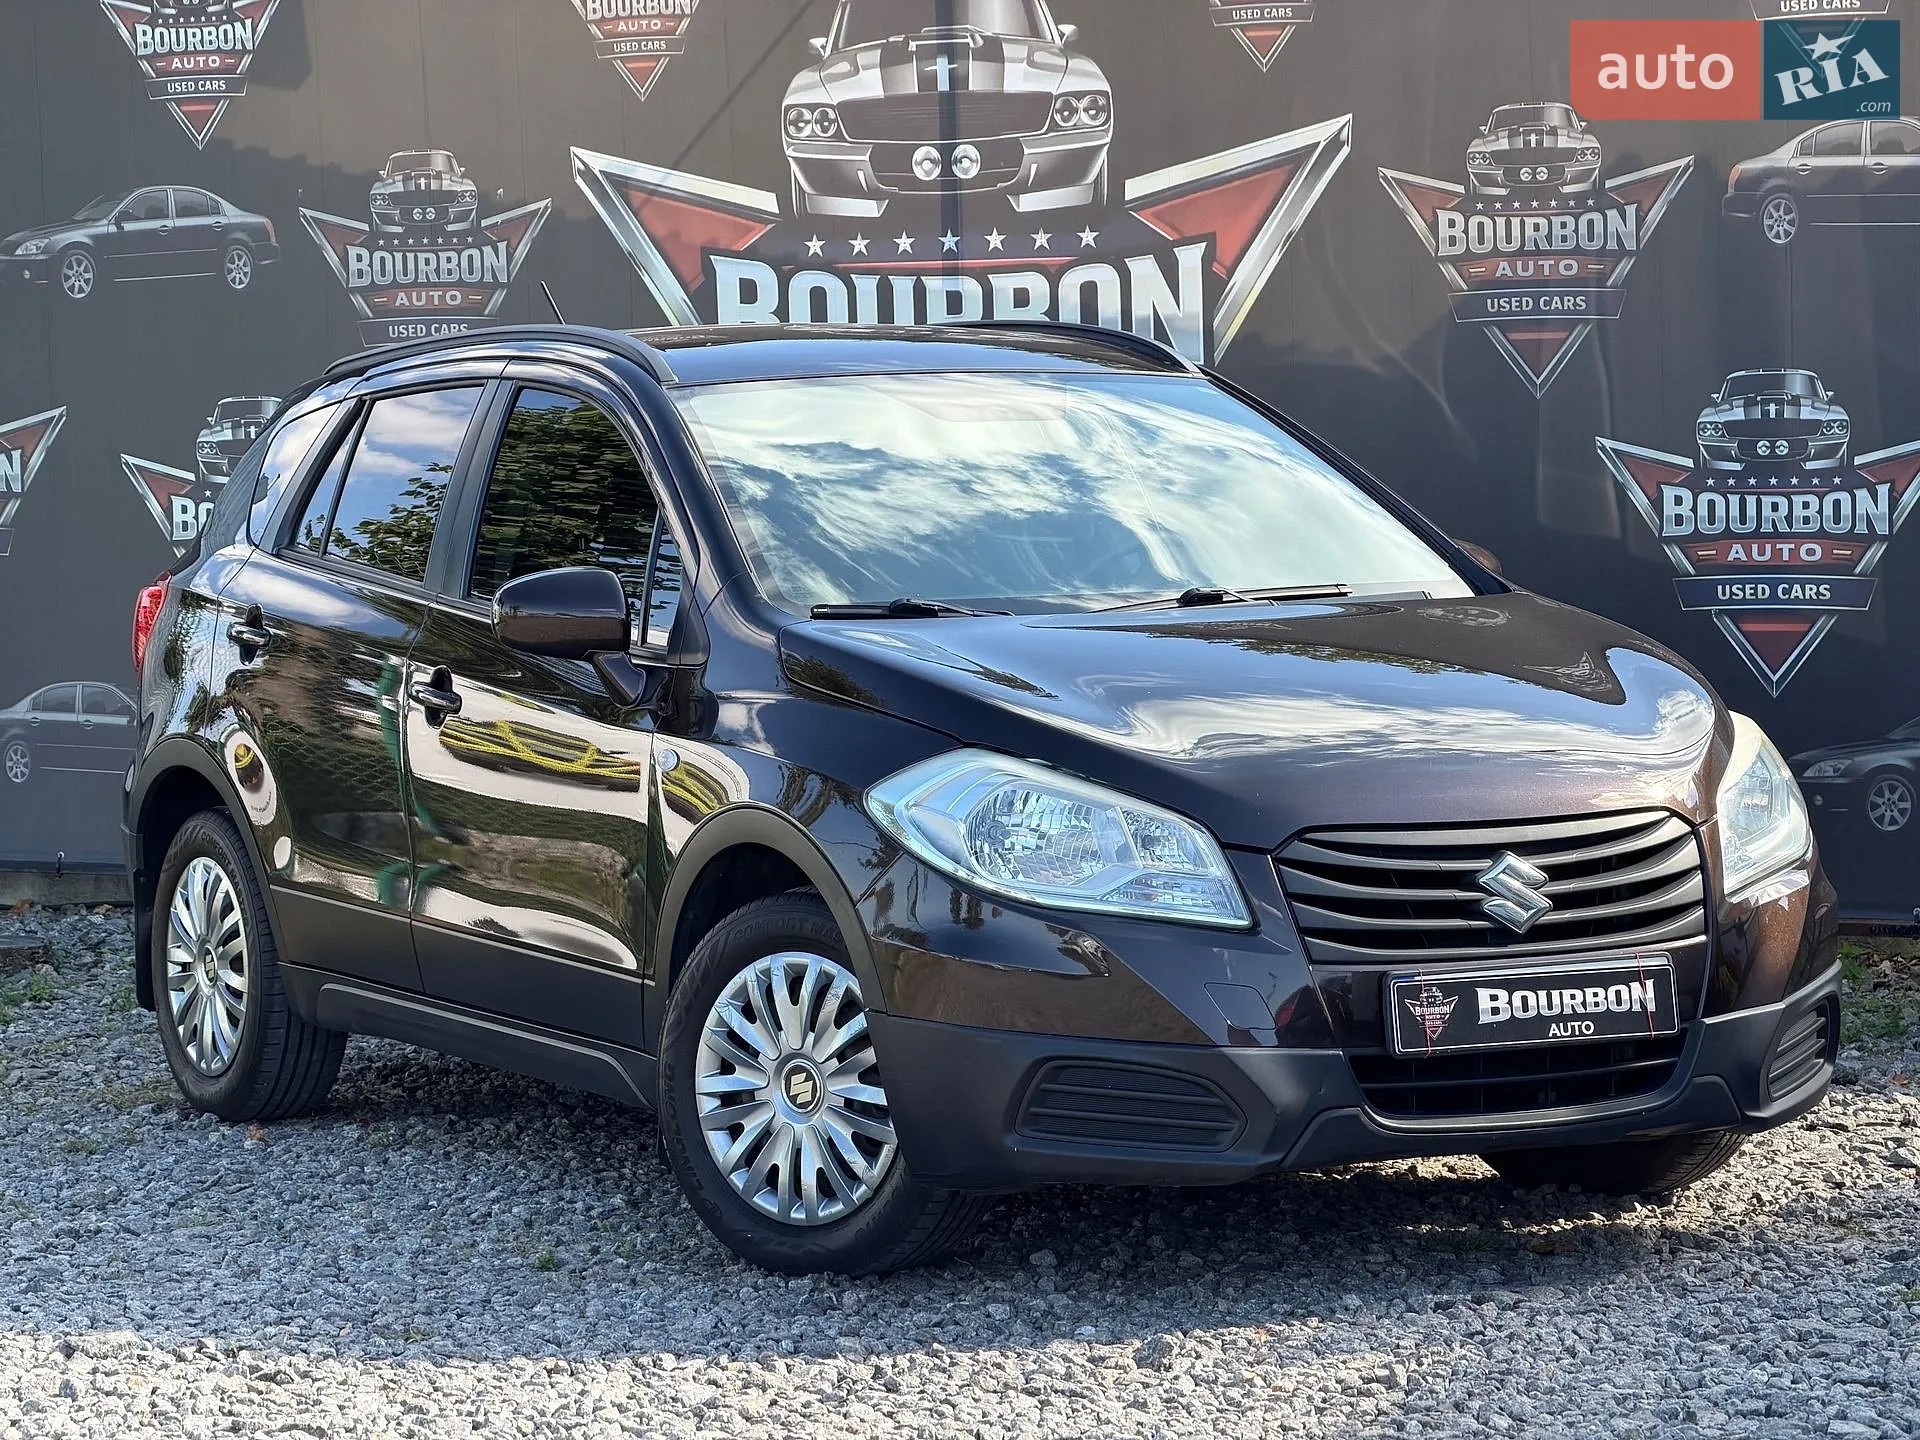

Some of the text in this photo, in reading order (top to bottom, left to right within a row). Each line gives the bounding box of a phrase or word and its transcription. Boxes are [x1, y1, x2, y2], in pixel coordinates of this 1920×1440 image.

[1232, 7, 1293, 20] USED CARS
[1780, 0, 1818, 12] USED
[617, 19, 661, 32] AUTO
[135, 18, 254, 56] BOURBON
[613, 40, 667, 52] USED CARS
[171, 56, 221, 69] AUTO
[167, 80, 226, 93] USED CARS
[1436, 203, 1639, 257] BOURBON
[346, 240, 508, 288] BOURBON
[1495, 258, 1580, 277] AUTO
[394, 289, 463, 307] AUTO
[1486, 295, 1587, 313] USED CARS
[388, 325, 427, 339] USED
[1660, 482, 1892, 538] BOURBON
[1726, 542, 1823, 562] AUTO
[1716, 583, 1832, 601] USED CARS
[1414, 1004, 1450, 1016] BOURBON
[1474, 978, 1656, 1025] BOURBON
[1548, 1020, 1595, 1038] AUTO
